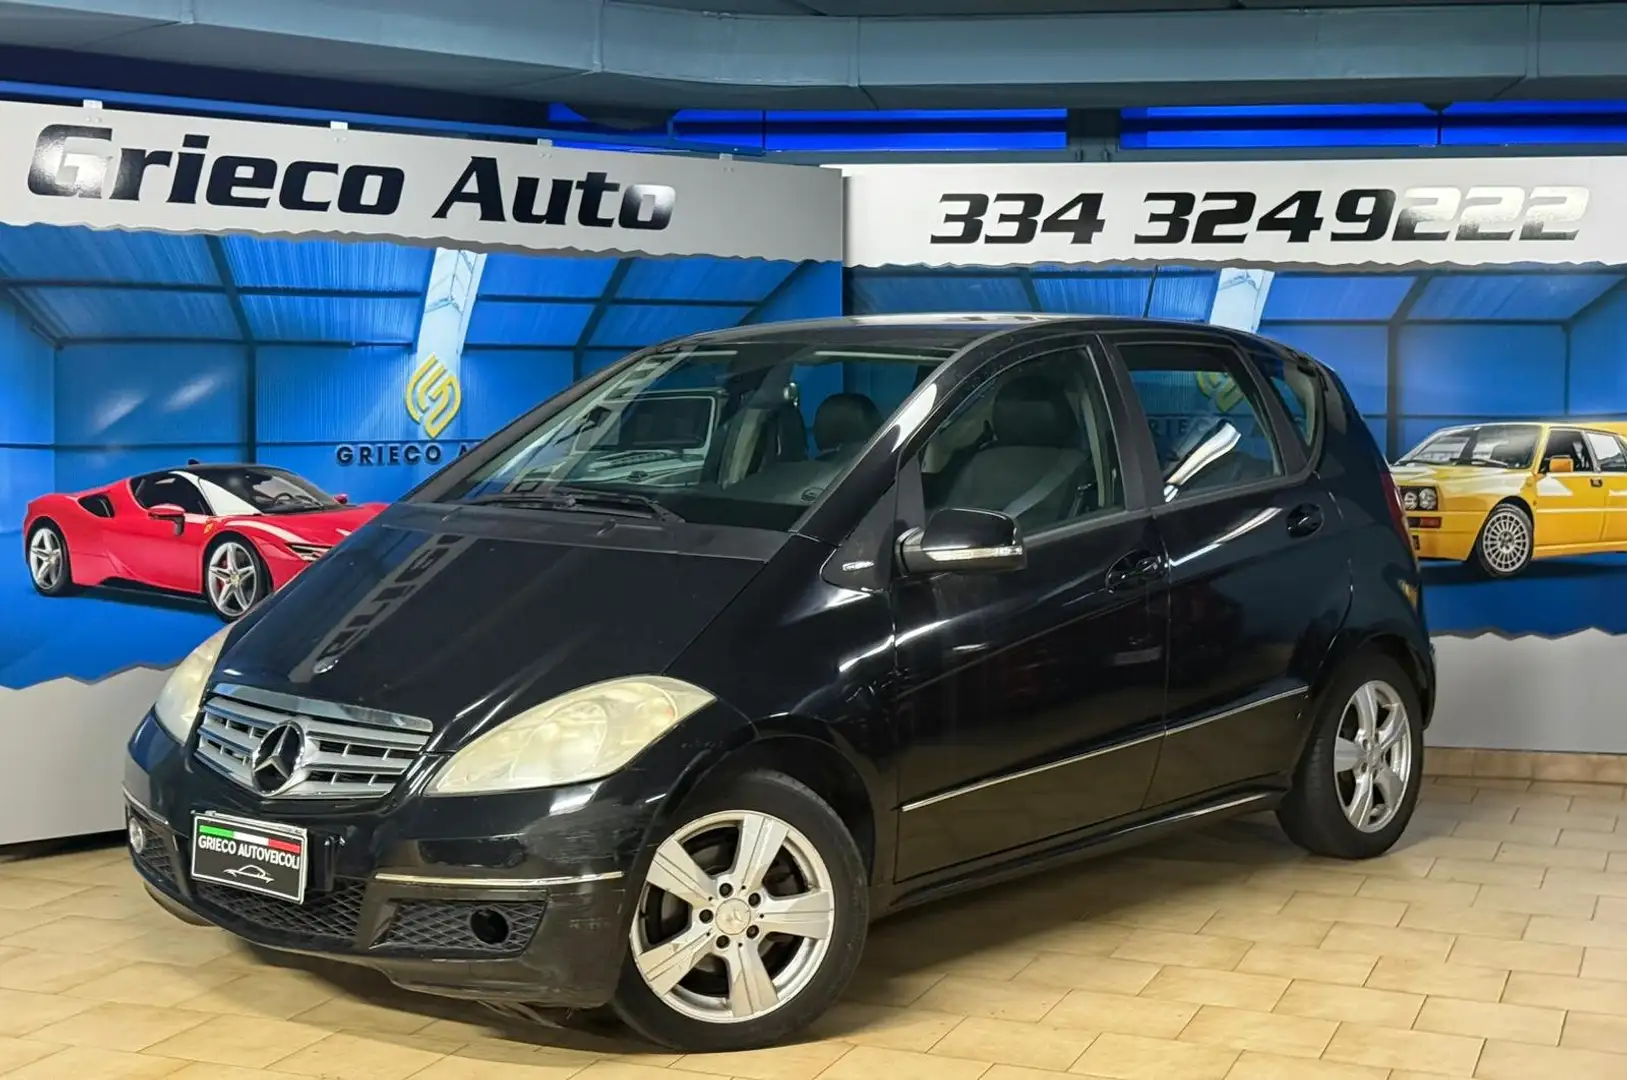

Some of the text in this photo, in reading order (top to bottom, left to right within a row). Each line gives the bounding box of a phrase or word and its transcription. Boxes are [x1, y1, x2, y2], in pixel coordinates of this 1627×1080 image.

[27, 124, 676, 231] Grieco Auto
[929, 186, 1590, 245] 334 3249222
[336, 443, 442, 466] GRIECO
[198, 835, 300, 869] GRIECO AUTOVEICOLI
